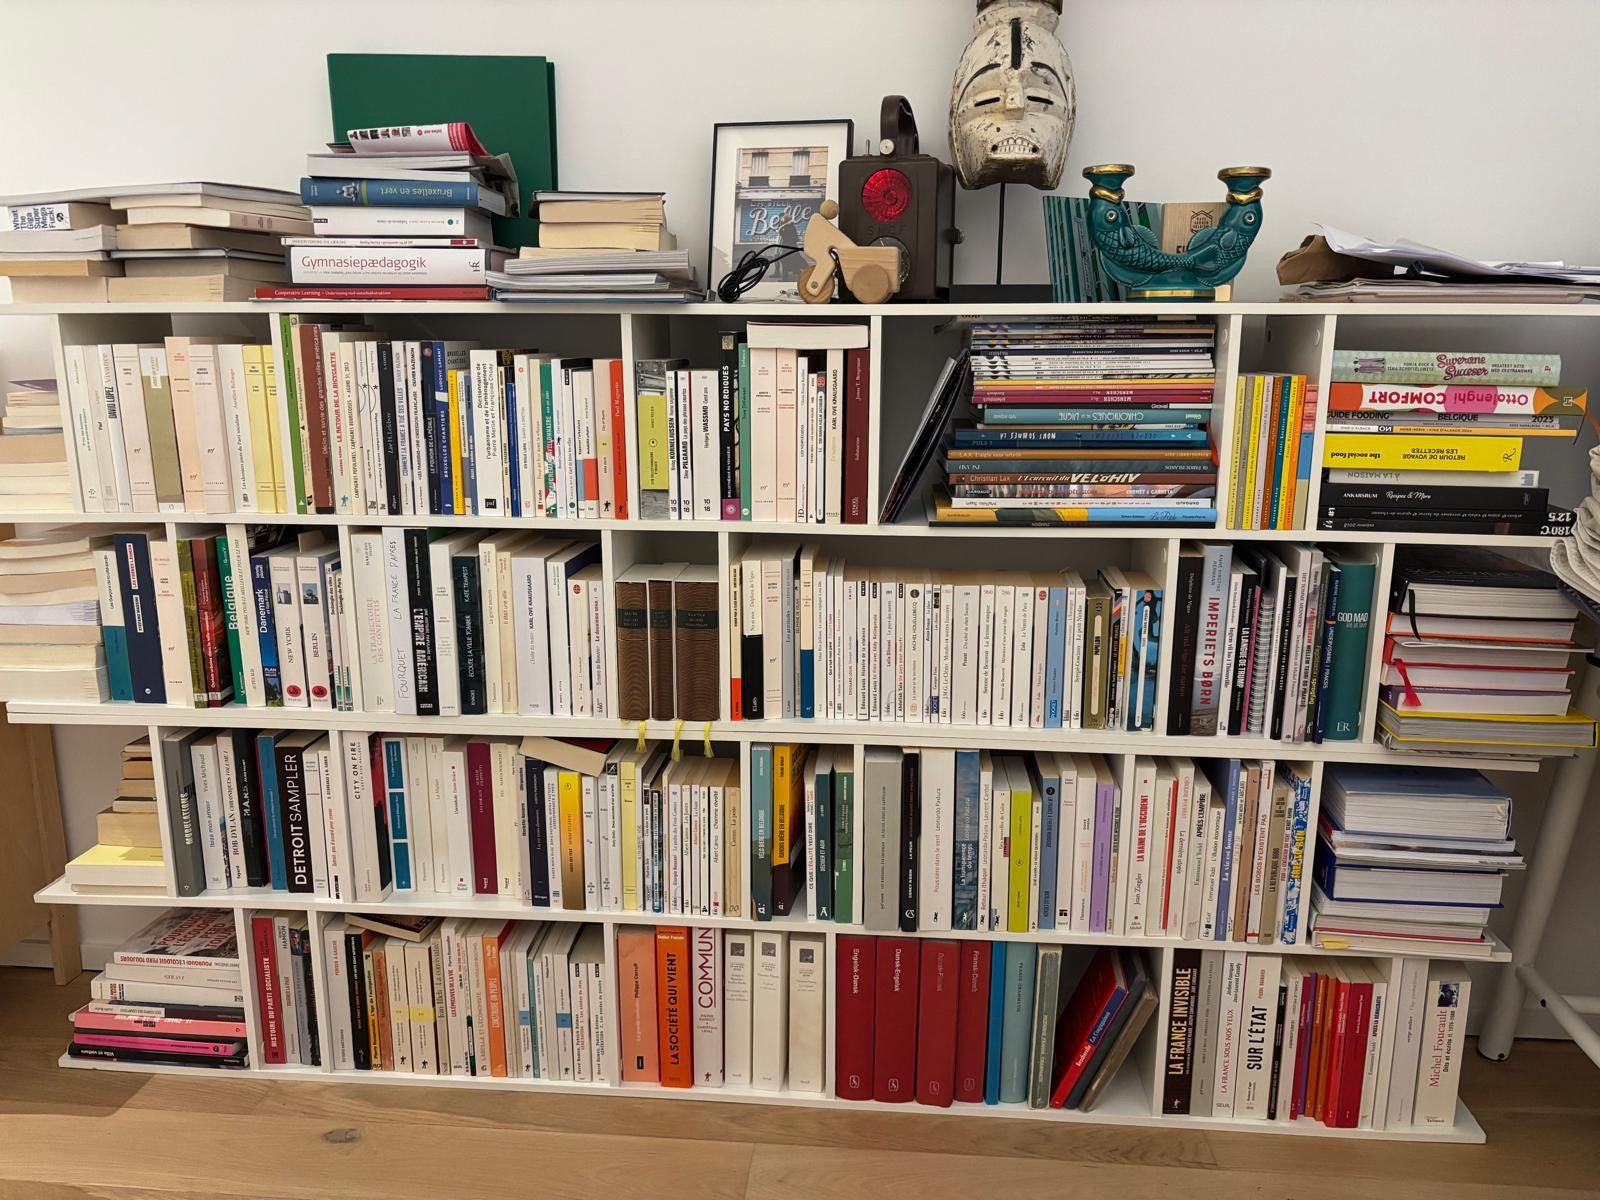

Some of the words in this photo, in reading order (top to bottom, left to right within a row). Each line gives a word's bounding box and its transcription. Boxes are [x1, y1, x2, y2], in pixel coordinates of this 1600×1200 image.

[412, 188, 453, 197] Bruxelles
[301, 256, 427, 270] Gymnasiepædagogik
[312, 326, 320, 360] américaines
[101, 353, 111, 384] Vivance
[330, 352, 338, 388] BICYCLETTE
[104, 386, 115, 403] LOPEZ
[316, 377, 324, 399] grandes
[332, 390, 339, 398] LA
[1368, 391, 1447, 404] COMFORT
[1454, 393, 1529, 406] Ottolenghi
[105, 403, 117, 419] DAVID
[333, 399, 340, 408] DE
[1352, 412, 1390, 420] FOODING
[1437, 413, 1478, 422] BELGIQUE
[223, 576, 239, 630] Belgique
[256, 589, 268, 633] Danemark
[393, 608, 402, 620] LA
[413, 608, 426, 646] L'EMPIRE
[1338, 612, 1354, 623] GOD
[1355, 612, 1368, 623] MAD
[1202, 597, 1220, 666] IMPERIETS
[397, 648, 410, 698] FOURQUET
[417, 649, 429, 692] AMÉRICAIN
[1236, 666, 1245, 688] TRUMP
[1200, 672, 1214, 705] BØRN
[352, 764, 359, 776] ON
[284, 754, 302, 822] SAMPLER
[1138, 795, 1149, 828] L'OCCIDENT
[229, 812, 238, 838] DYLAN
[231, 839, 240, 855] BOB
[291, 824, 308, 885] DETROIT
[1136, 838, 1146, 854] HAINE
[1134, 873, 1143, 892] Ziegler
[1133, 893, 1143, 905] Jean
[263, 958, 272, 991] SOCIALISTE
[666, 953, 677, 982] VIENT
[697, 928, 714, 1008] COMMUN
[667, 985, 677, 1005] QUI
[1173, 968, 1191, 1017] INVISIBLE
[269, 1020, 277, 1047] HISTOIRE
[666, 1007, 679, 1051] SOCIÉTÉ
[1247, 1006, 1267, 1044] L'ÉTAT
[1433, 1010, 1447, 1051] Foucault
[1170, 1020, 1187, 1059] FRANCE
[670, 1054, 679, 1065] LA
[1168, 1063, 1184, 1075] LA
[1246, 1047, 1263, 1070] SUR
[1221, 1060, 1230, 1083] FRANCE
[1429, 1055, 1442, 1087] Michel
[1221, 1084, 1227, 1093] LA
